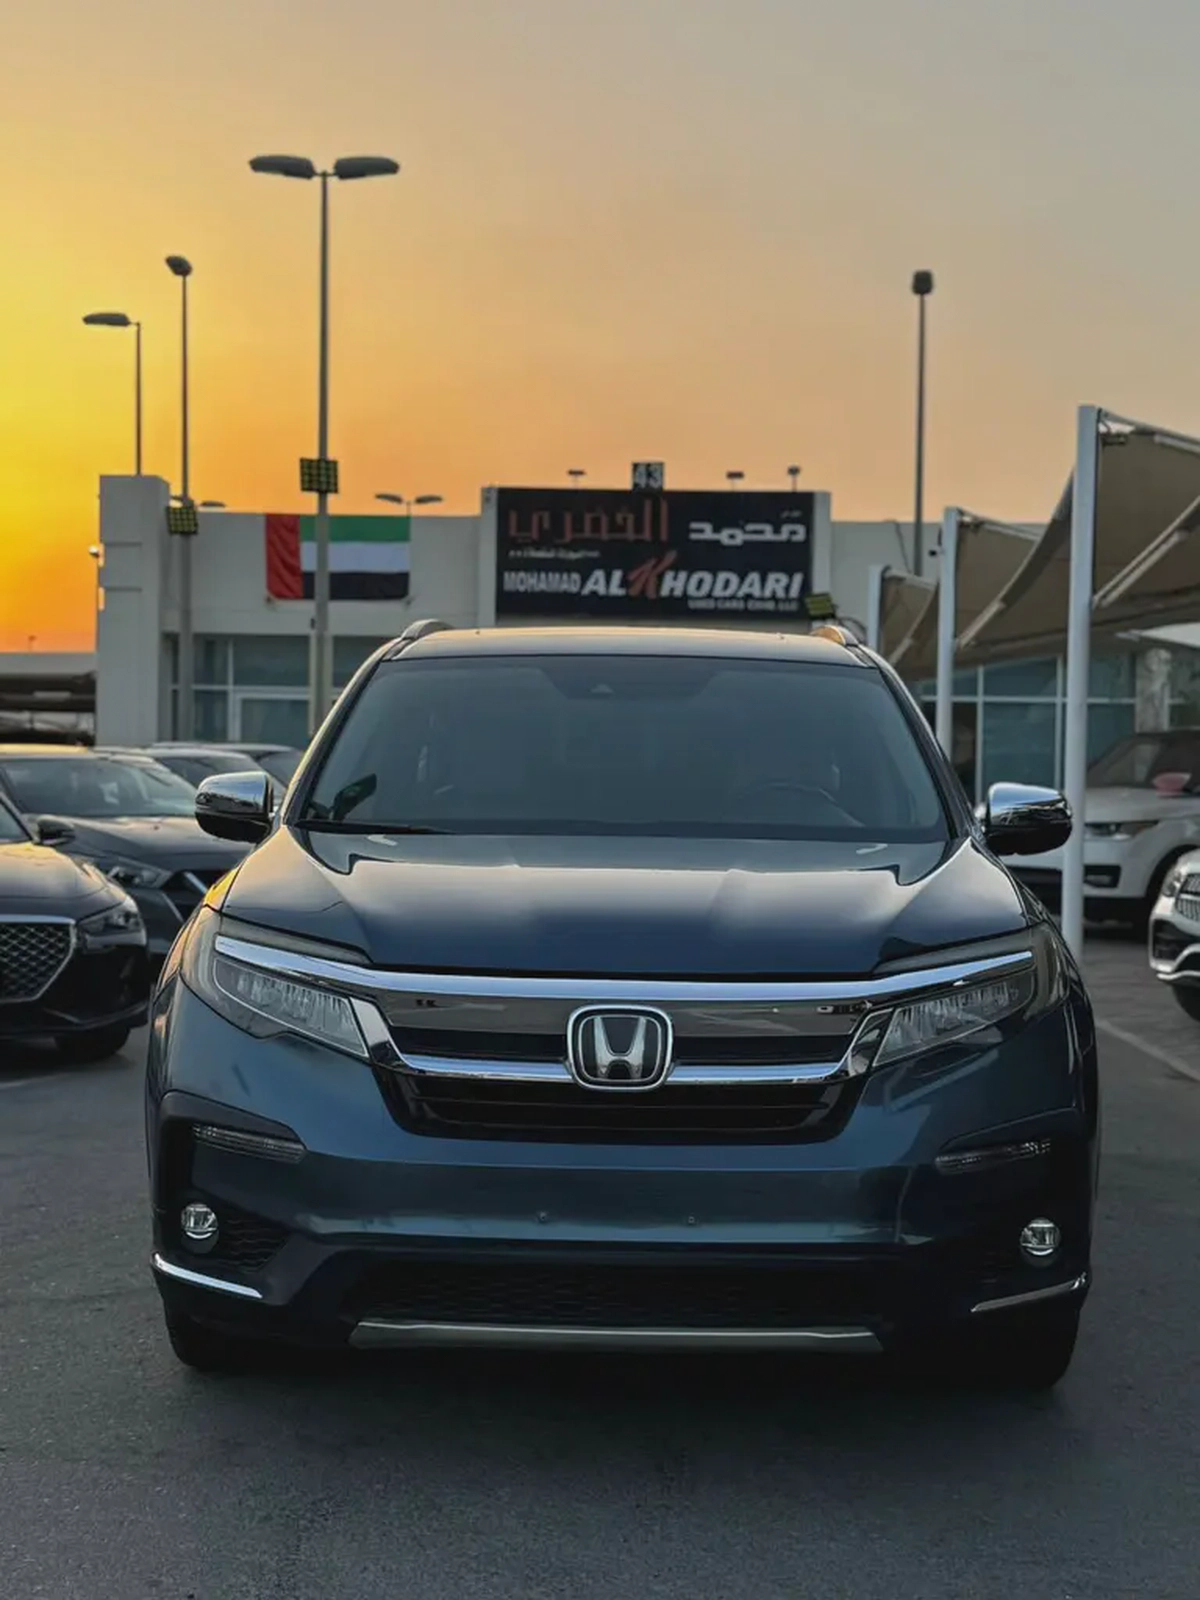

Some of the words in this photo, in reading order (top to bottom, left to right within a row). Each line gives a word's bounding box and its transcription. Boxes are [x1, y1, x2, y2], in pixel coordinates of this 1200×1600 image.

[633, 463, 662, 488] 43
[688, 520, 807, 546] محمد
[503, 571, 582, 594] MOHAMAD
[581, 568, 627, 596] AL
